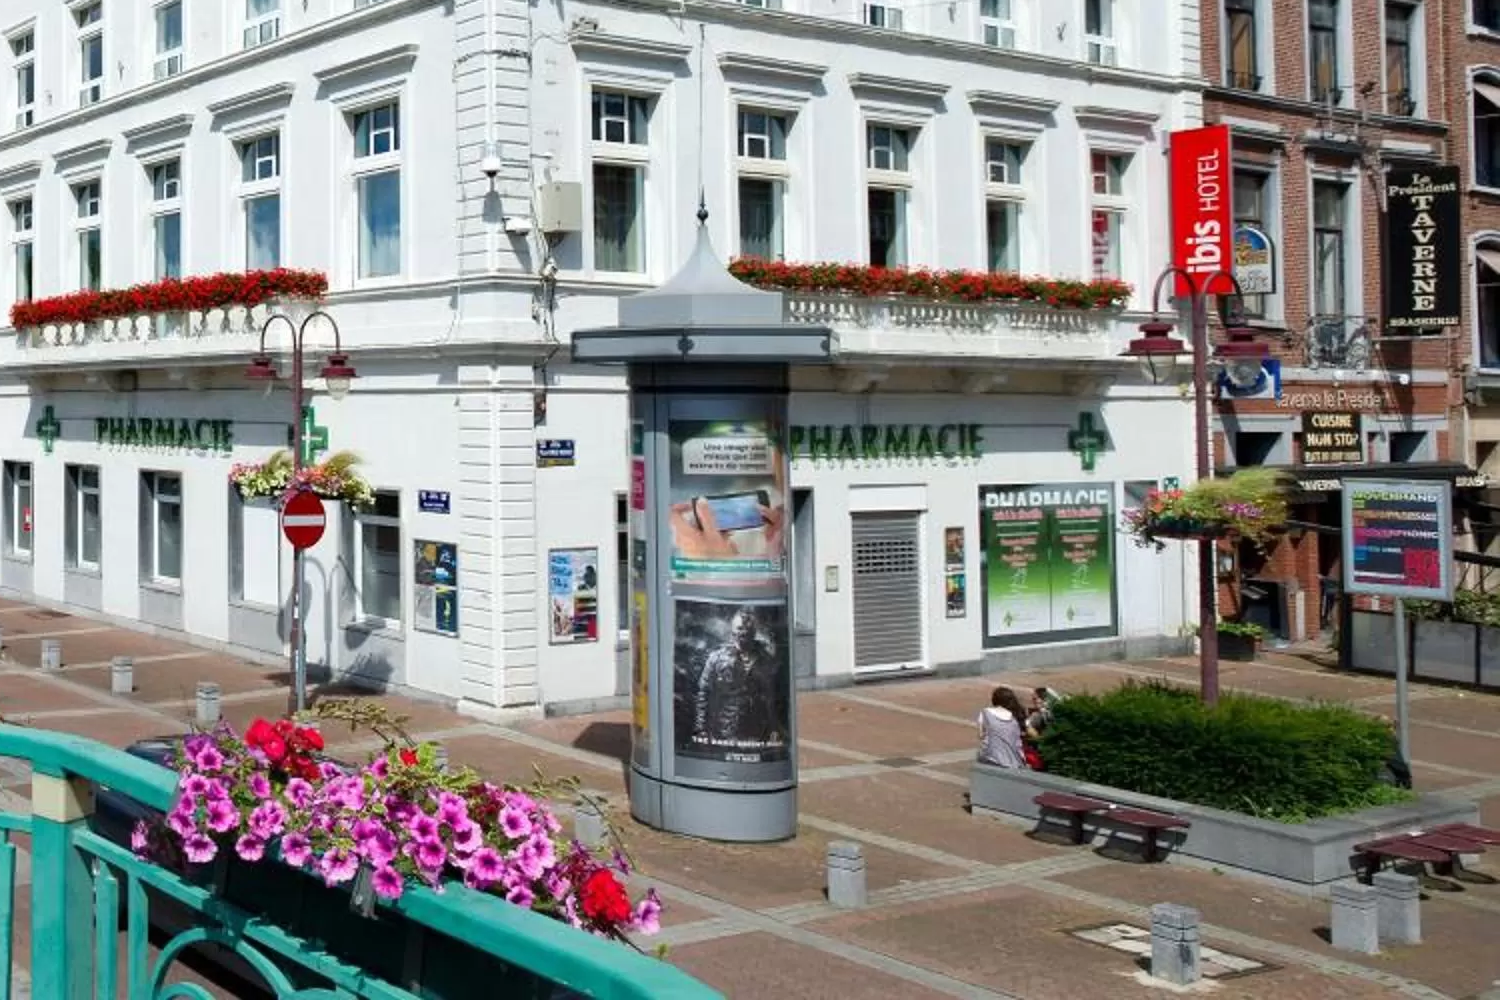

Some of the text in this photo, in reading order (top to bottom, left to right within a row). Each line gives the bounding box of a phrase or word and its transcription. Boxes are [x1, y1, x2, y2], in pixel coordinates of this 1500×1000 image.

[1185, 148, 1221, 273] ibis HOTEL
[1411, 195, 1437, 311] TAVERNE
[95, 417, 234, 452] PHARMACIE
[790, 424, 985, 461] PHARMACIE
[985, 489, 1109, 507] PHARMACIE
